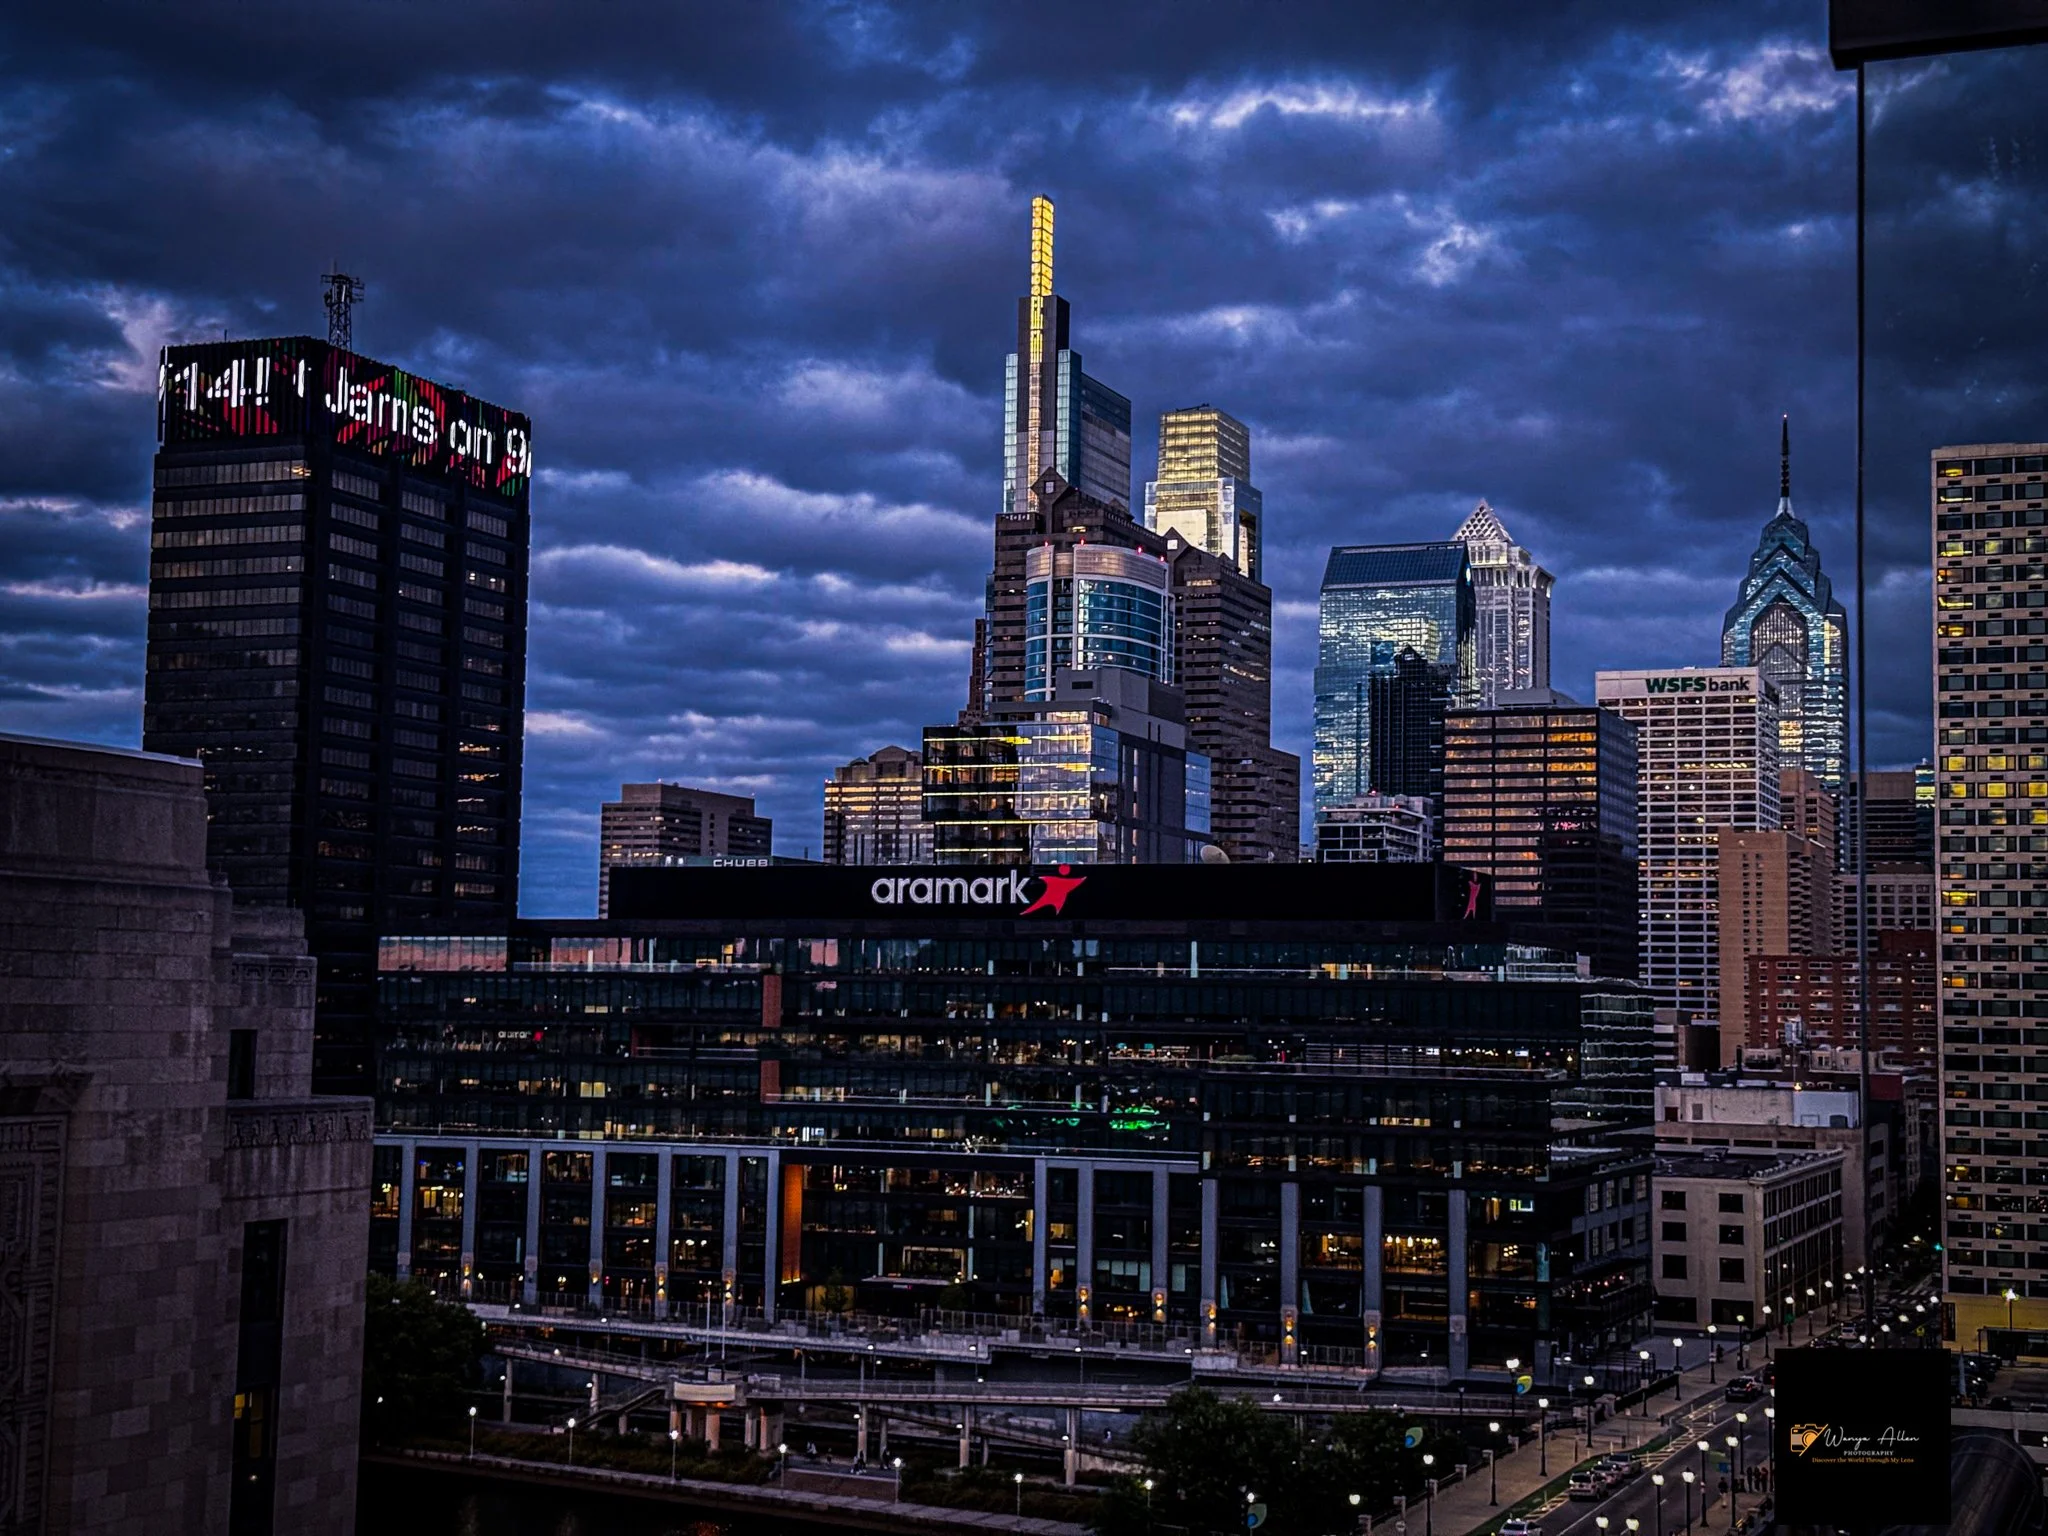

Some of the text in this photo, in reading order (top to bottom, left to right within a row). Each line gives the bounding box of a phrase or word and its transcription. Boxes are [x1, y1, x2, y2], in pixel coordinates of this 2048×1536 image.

[325, 365, 438, 445] Jams
[449, 418, 493, 465] on
[1645, 677, 1750, 693] WSFS bank
[713, 859, 768, 867] CHUBB
[871, 869, 1030, 904] aramark
